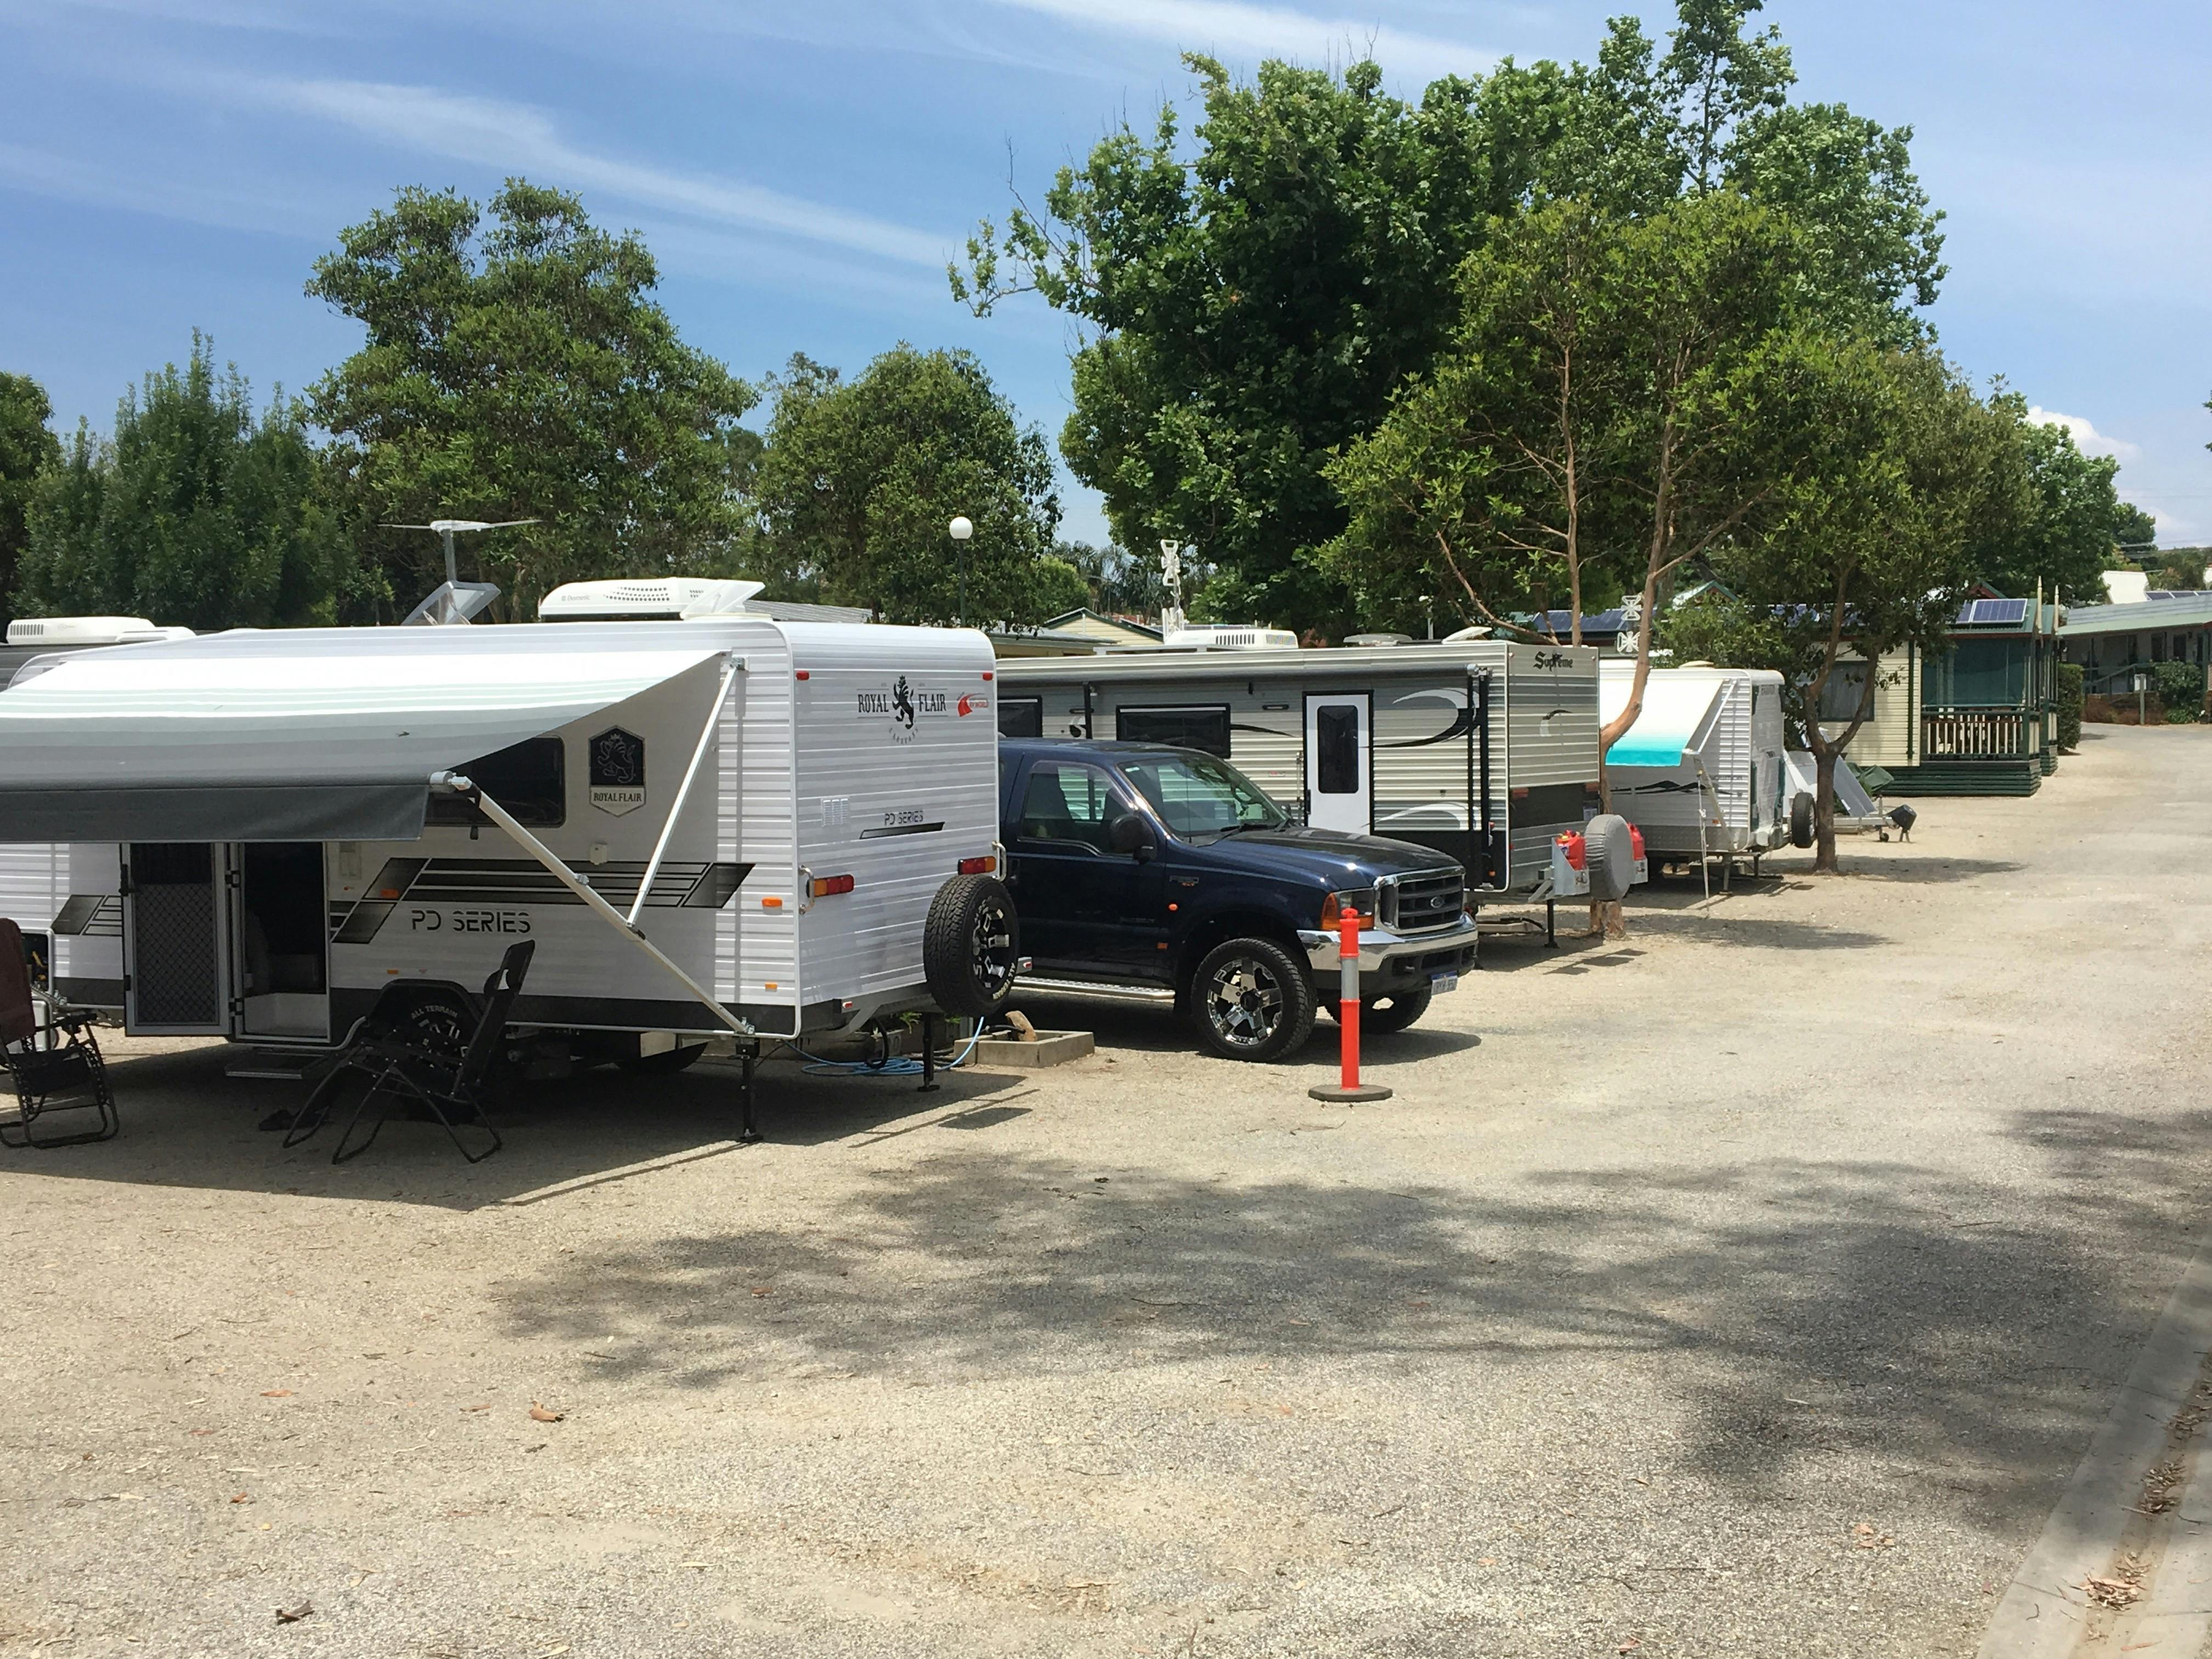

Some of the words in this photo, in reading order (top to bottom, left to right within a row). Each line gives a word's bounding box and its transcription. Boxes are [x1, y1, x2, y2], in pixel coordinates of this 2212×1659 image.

[857, 694, 889, 713] ROYAL
[918, 693, 947, 712] FLAIR
[594, 792, 617, 802] ROYAL
[618, 793, 642, 802] FLAIR
[884, 813, 895, 825] PD
[898, 810, 923, 824] SERIES
[411, 910, 441, 930] PD
[452, 910, 531, 933] SERIES
[411, 1008, 424, 1019] ALL
[425, 1005, 458, 1018] TERRAIN
